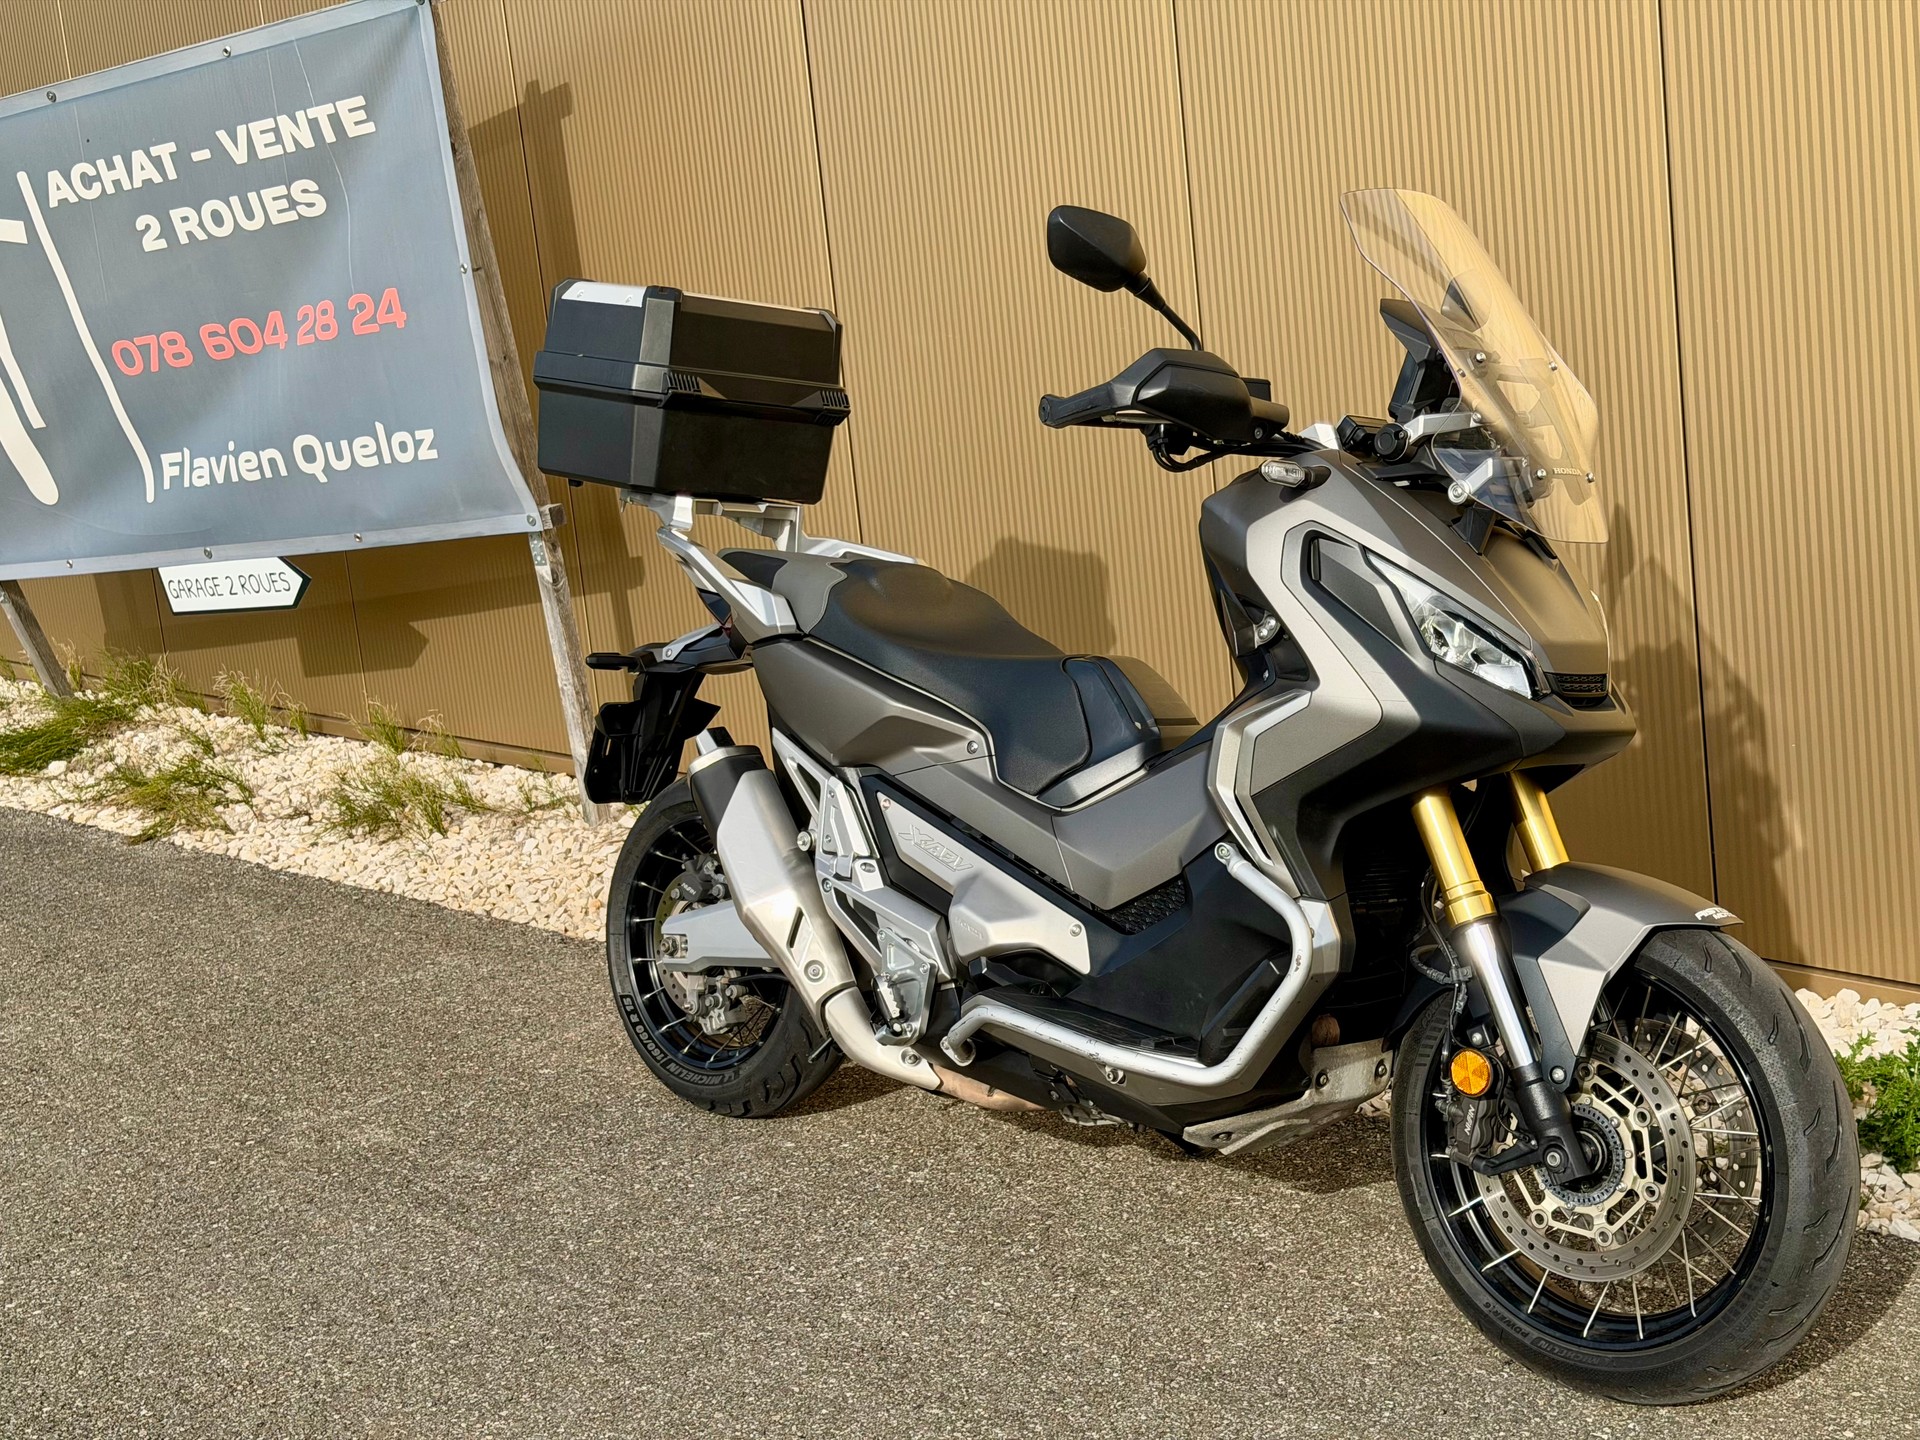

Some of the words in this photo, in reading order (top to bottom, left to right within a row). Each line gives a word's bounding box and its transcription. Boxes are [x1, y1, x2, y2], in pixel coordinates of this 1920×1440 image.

[47, 142, 178, 209] ACHAT
[190, 148, 211, 162] -
[215, 95, 376, 165] VENTE
[135, 214, 168, 252] 2
[168, 178, 327, 245] ROUES
[111, 331, 194, 376] 078
[199, 310, 288, 361] 604
[297, 300, 338, 345] 28
[348, 287, 407, 335] 24
[160, 440, 288, 490] Flavien
[292, 421, 439, 483] Queloz
[1553, 467, 1582, 476] HONDA
[167, 577, 224, 599] GARAGE
[225, 575, 238, 595] 2
[238, 571, 291, 595] ROUES
[622, 997, 634, 1012] 15
[629, 1013, 640, 1023] R
[635, 1025, 665, 1061] 160/60
[666, 1062, 723, 1085] MICHELIN
[1494, 1311, 1530, 1339] POWER
[1537, 1340, 1600, 1364] MICHELIN
